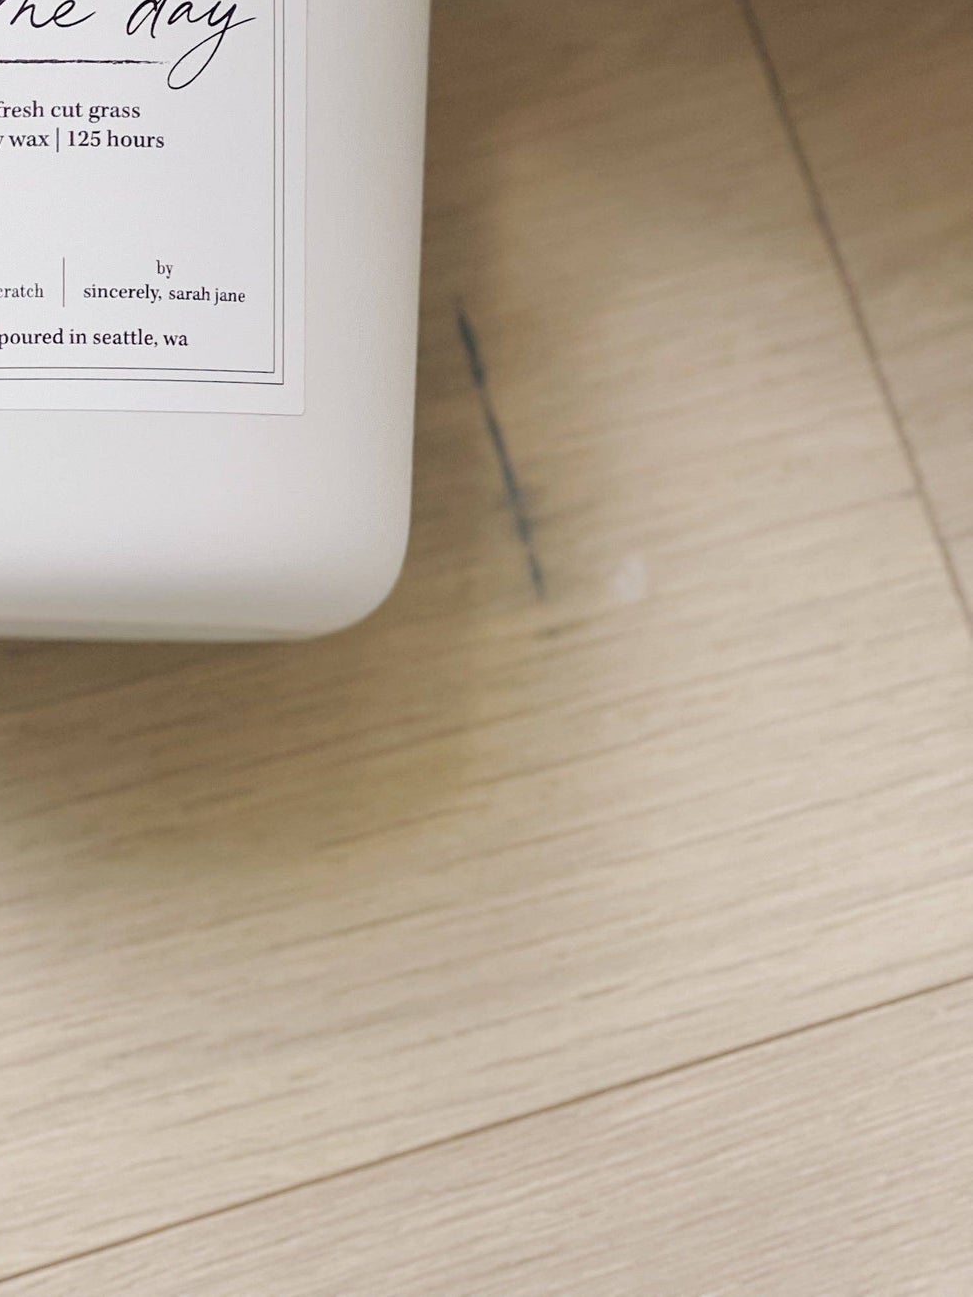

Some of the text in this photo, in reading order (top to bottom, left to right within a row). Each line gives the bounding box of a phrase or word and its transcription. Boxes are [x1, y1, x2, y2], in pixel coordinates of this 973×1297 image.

[50, 102, 83, 119] cut
[87, 106, 141, 122] grass
[8, 135, 50, 148] wax
[67, 129, 102, 148] 125
[106, 129, 165, 149] hours
[155, 259, 174, 279] by
[83, 283, 246, 307] sincerely, sarah jane
[68, 326, 88, 347] in
[92, 327, 159, 350] seattle,
[162, 332, 189, 348] wa
